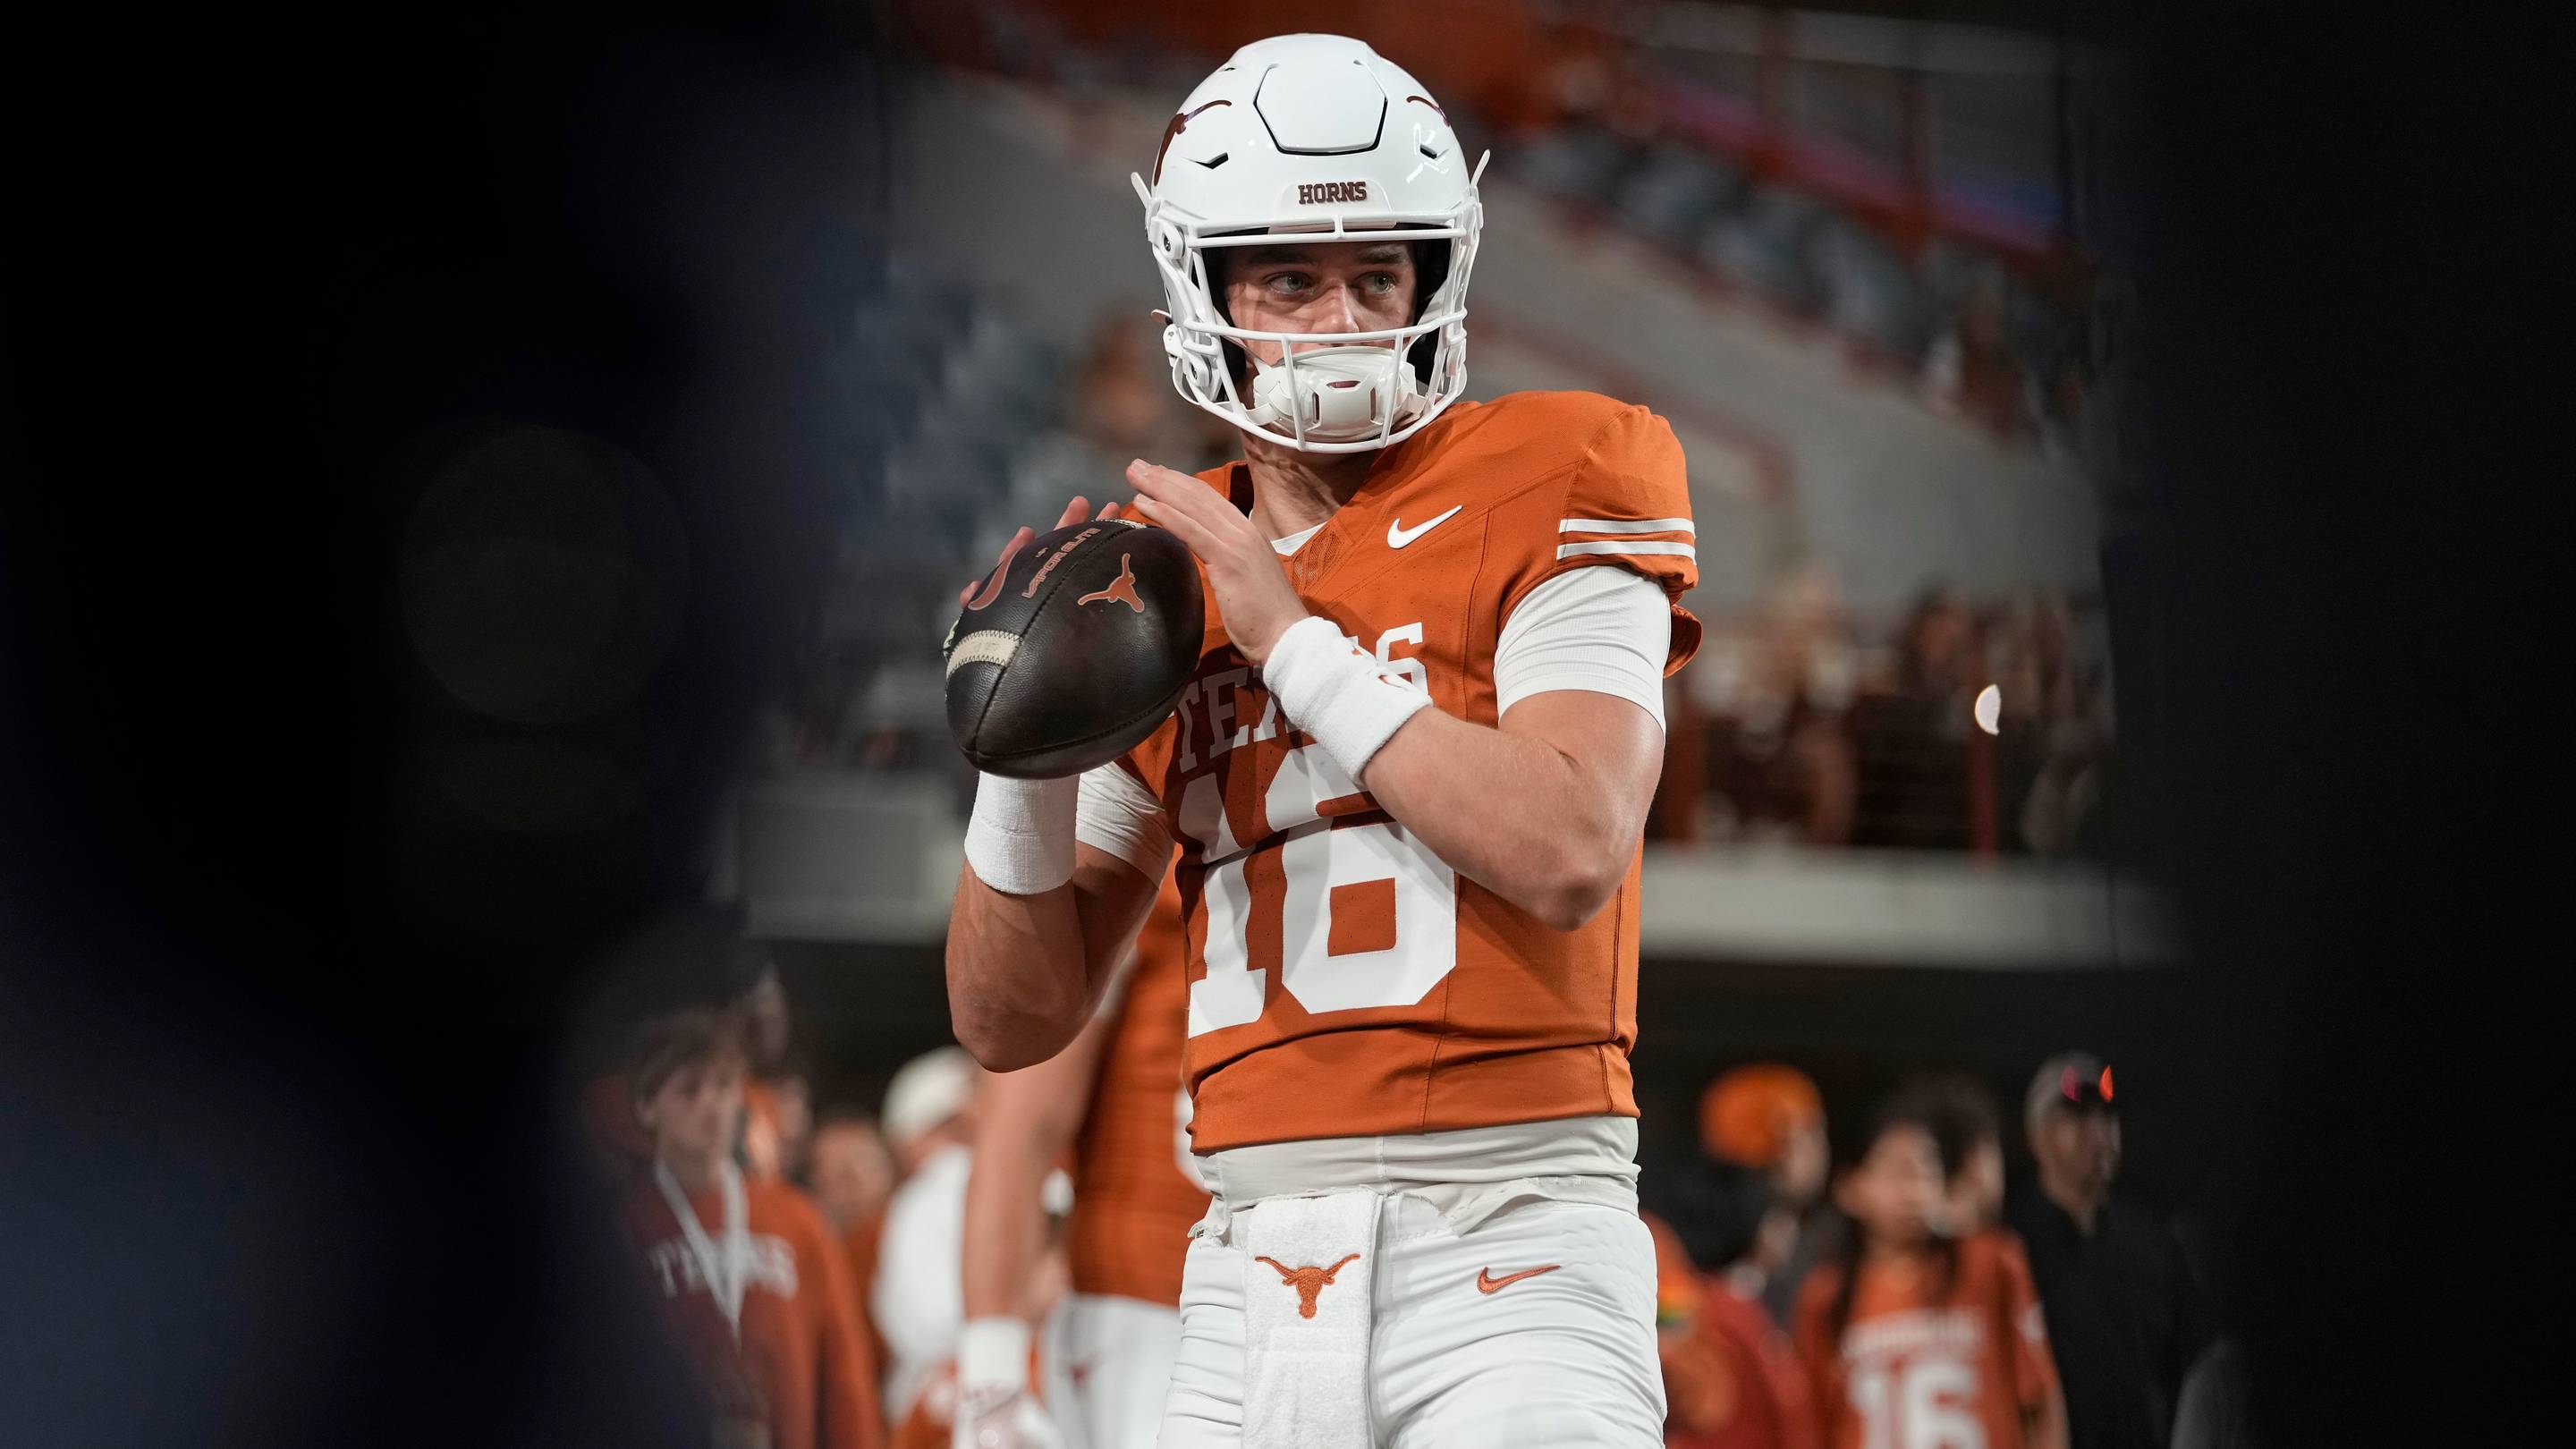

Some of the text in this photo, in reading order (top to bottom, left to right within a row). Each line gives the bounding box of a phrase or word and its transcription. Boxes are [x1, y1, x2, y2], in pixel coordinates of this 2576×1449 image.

[1298, 182, 1368, 205] HORNS
[1021, 528, 1102, 598] VAPOR ELITE
[1170, 622, 1429, 774] TES
[1179, 741, 1456, 1039] 16
[1847, 1360, 1990, 1448] 16
